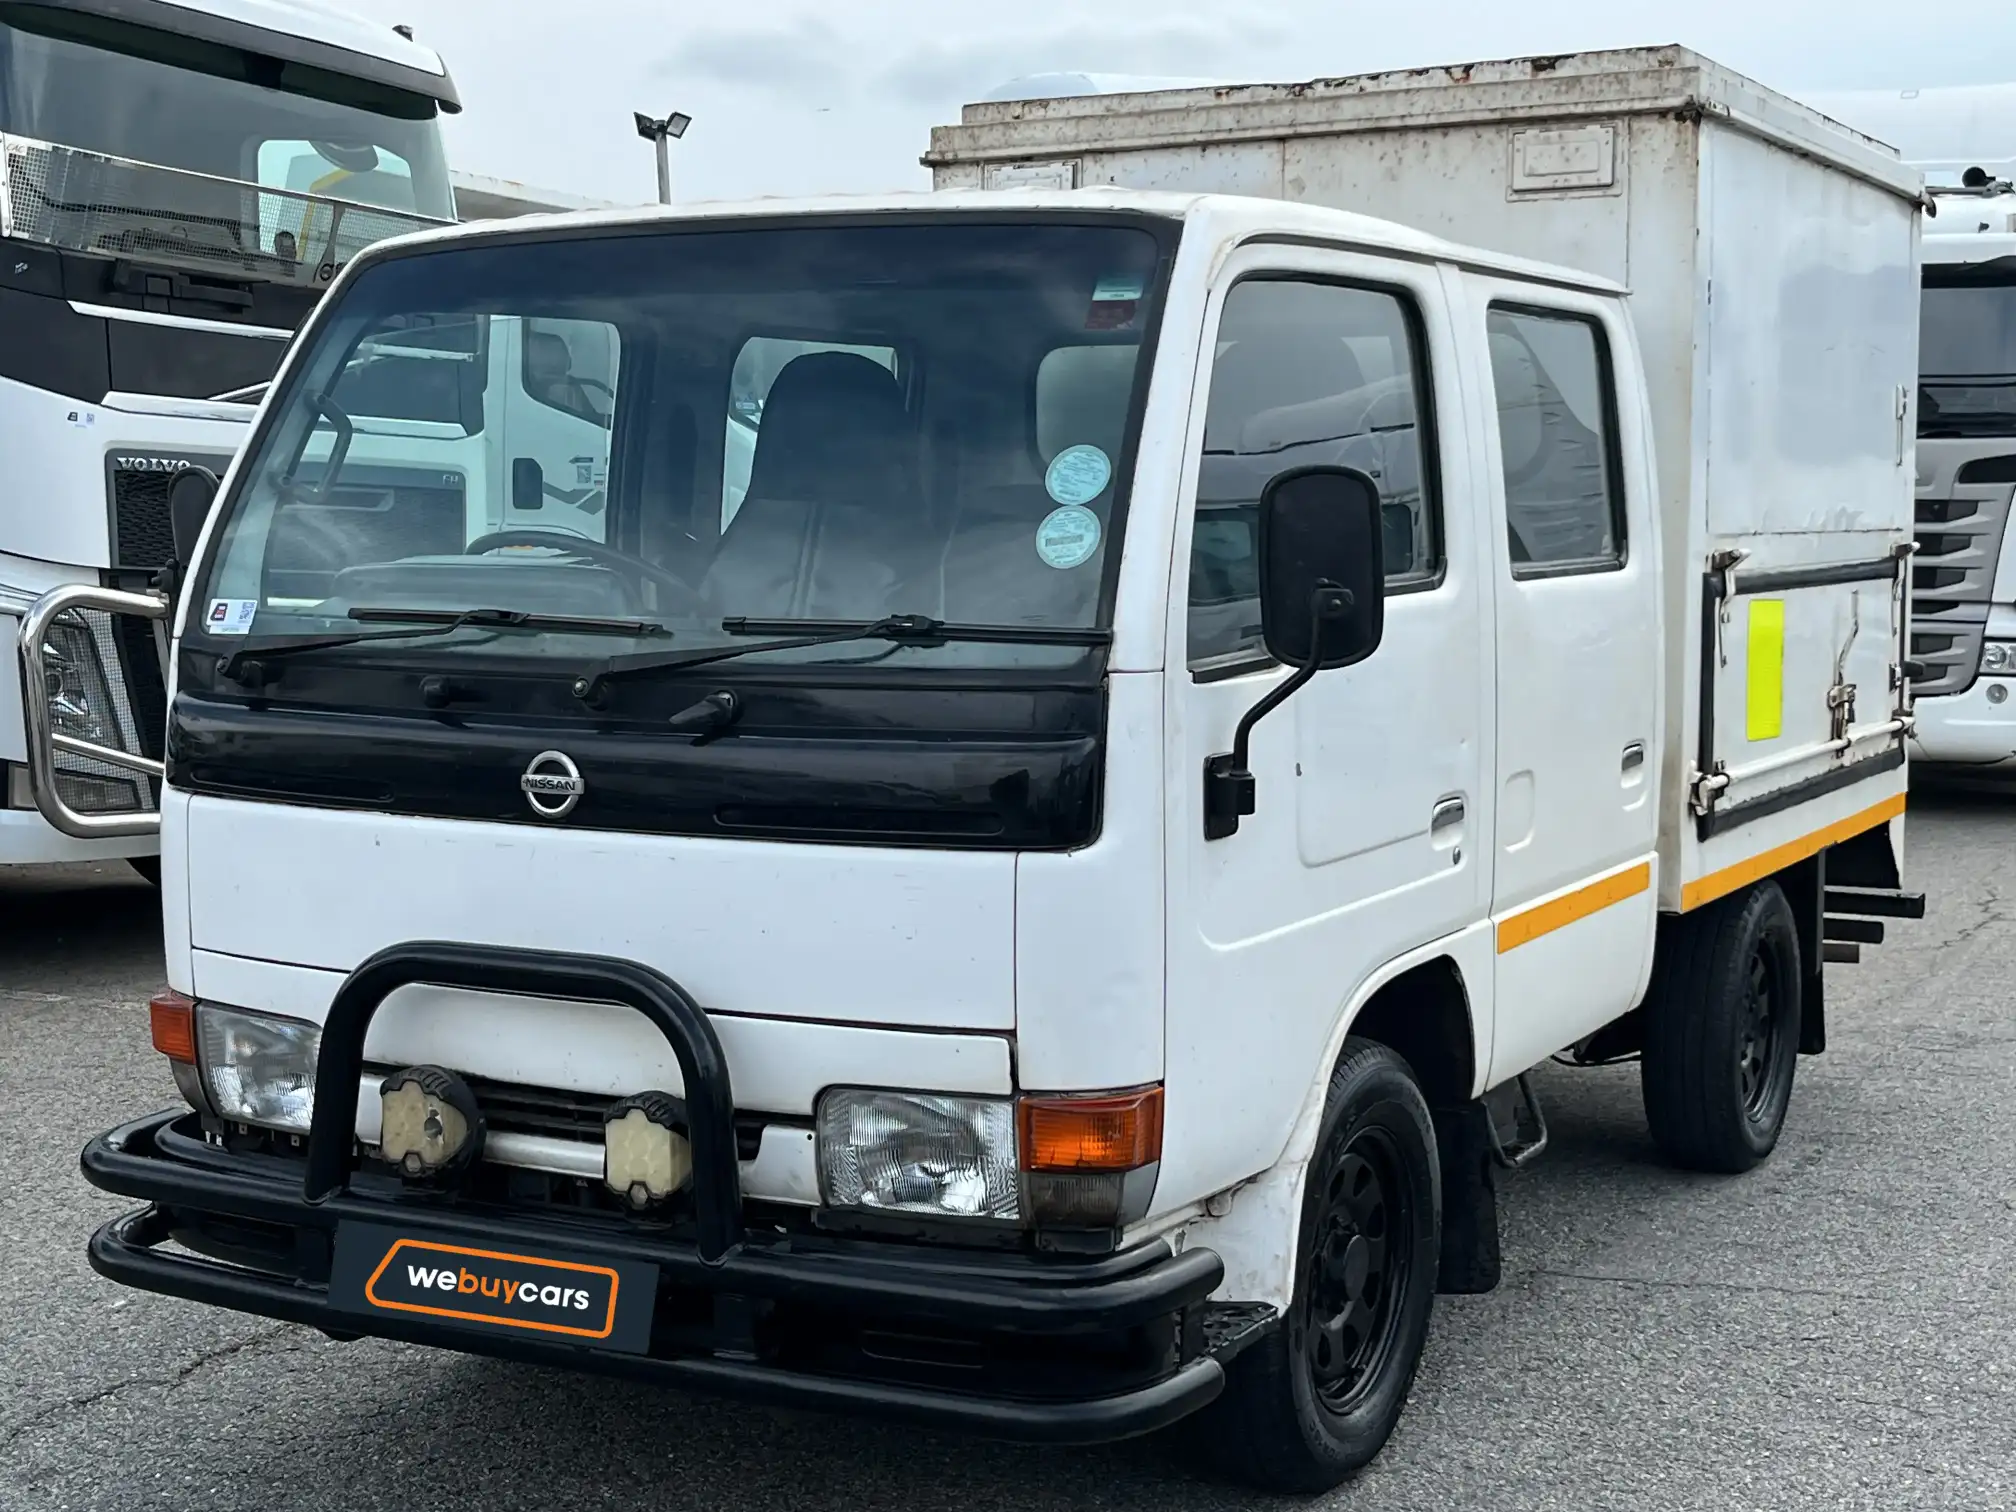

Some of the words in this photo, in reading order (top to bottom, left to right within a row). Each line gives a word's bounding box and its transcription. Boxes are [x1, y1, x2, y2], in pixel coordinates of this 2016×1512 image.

[116, 457, 191, 473] VOLVO
[525, 778, 576, 791] NISSAN
[407, 1265, 590, 1310] webuycars
